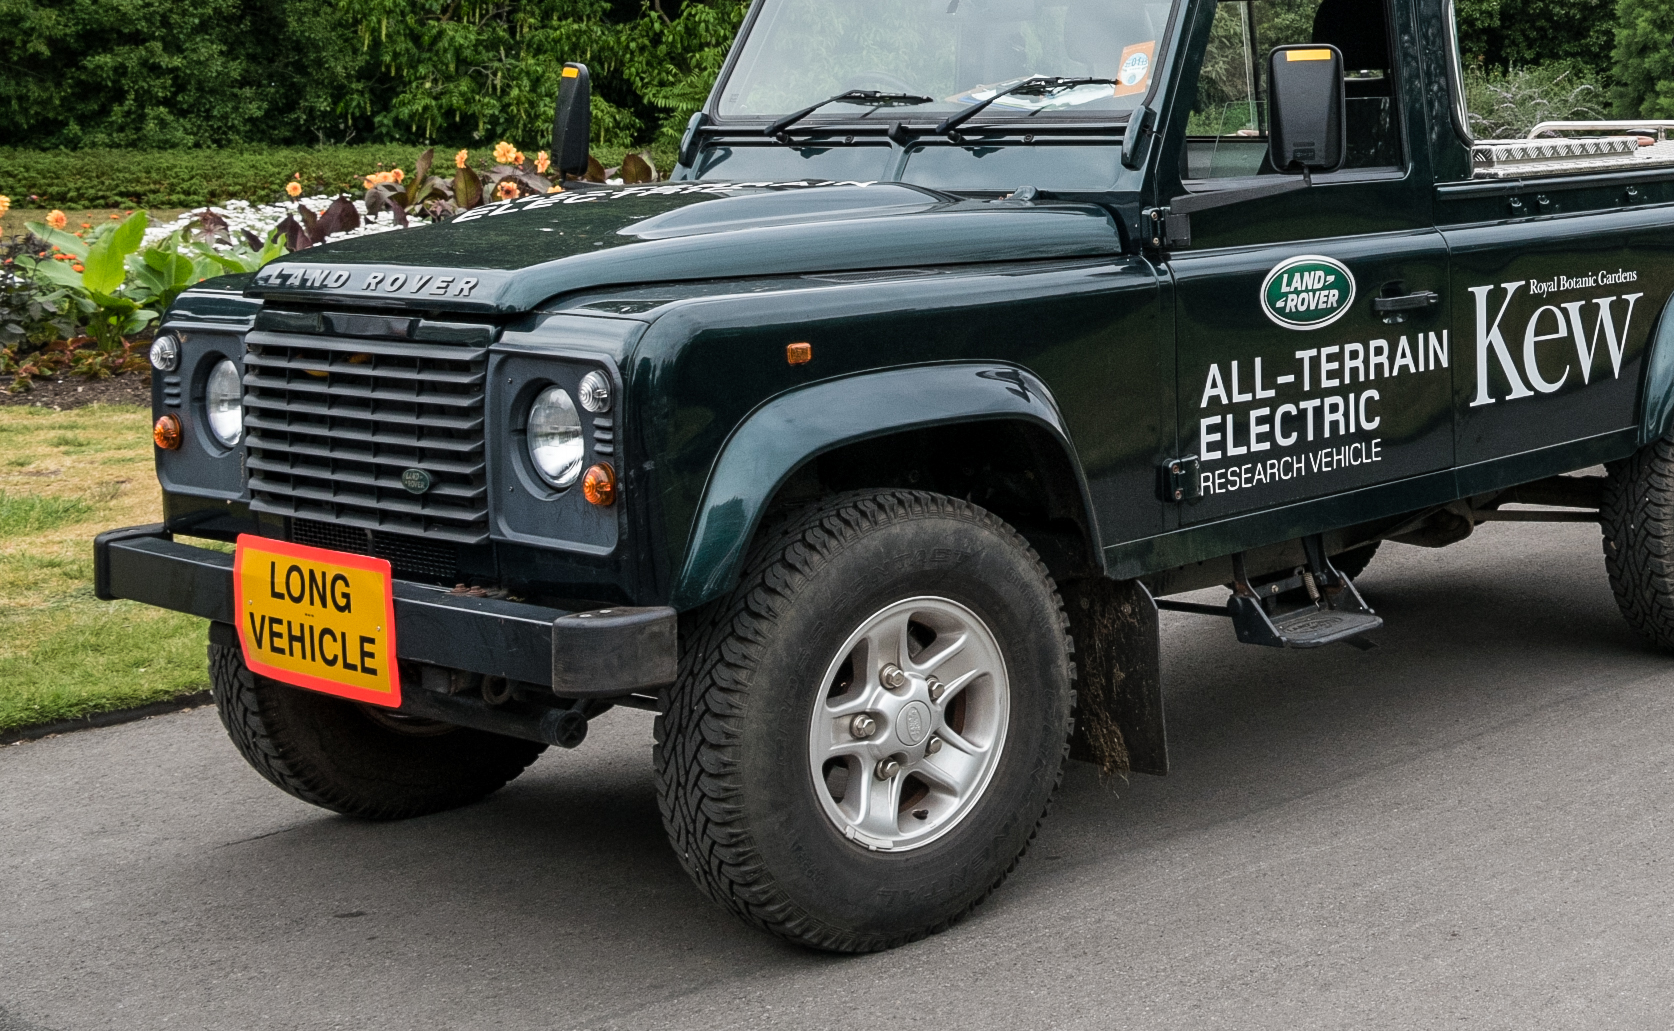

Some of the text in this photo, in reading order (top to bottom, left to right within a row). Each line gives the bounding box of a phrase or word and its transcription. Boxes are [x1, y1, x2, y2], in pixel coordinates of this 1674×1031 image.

[269, 267, 479, 296] LAND ROVER
[1280, 270, 1326, 292] LAND
[1285, 294, 1341, 313] ROVER
[1529, 268, 1637, 298] Royal Botanic Gardens
[1200, 329, 1449, 408] ALL-TERRAIN
[1467, 281, 1644, 407] Kew
[1200, 389, 1381, 461] ELECTRIC
[1200, 439, 1382, 496] RESEARCH VEHICLE
[269, 560, 353, 615] LONG
[249, 611, 378, 676] VEHICLE
